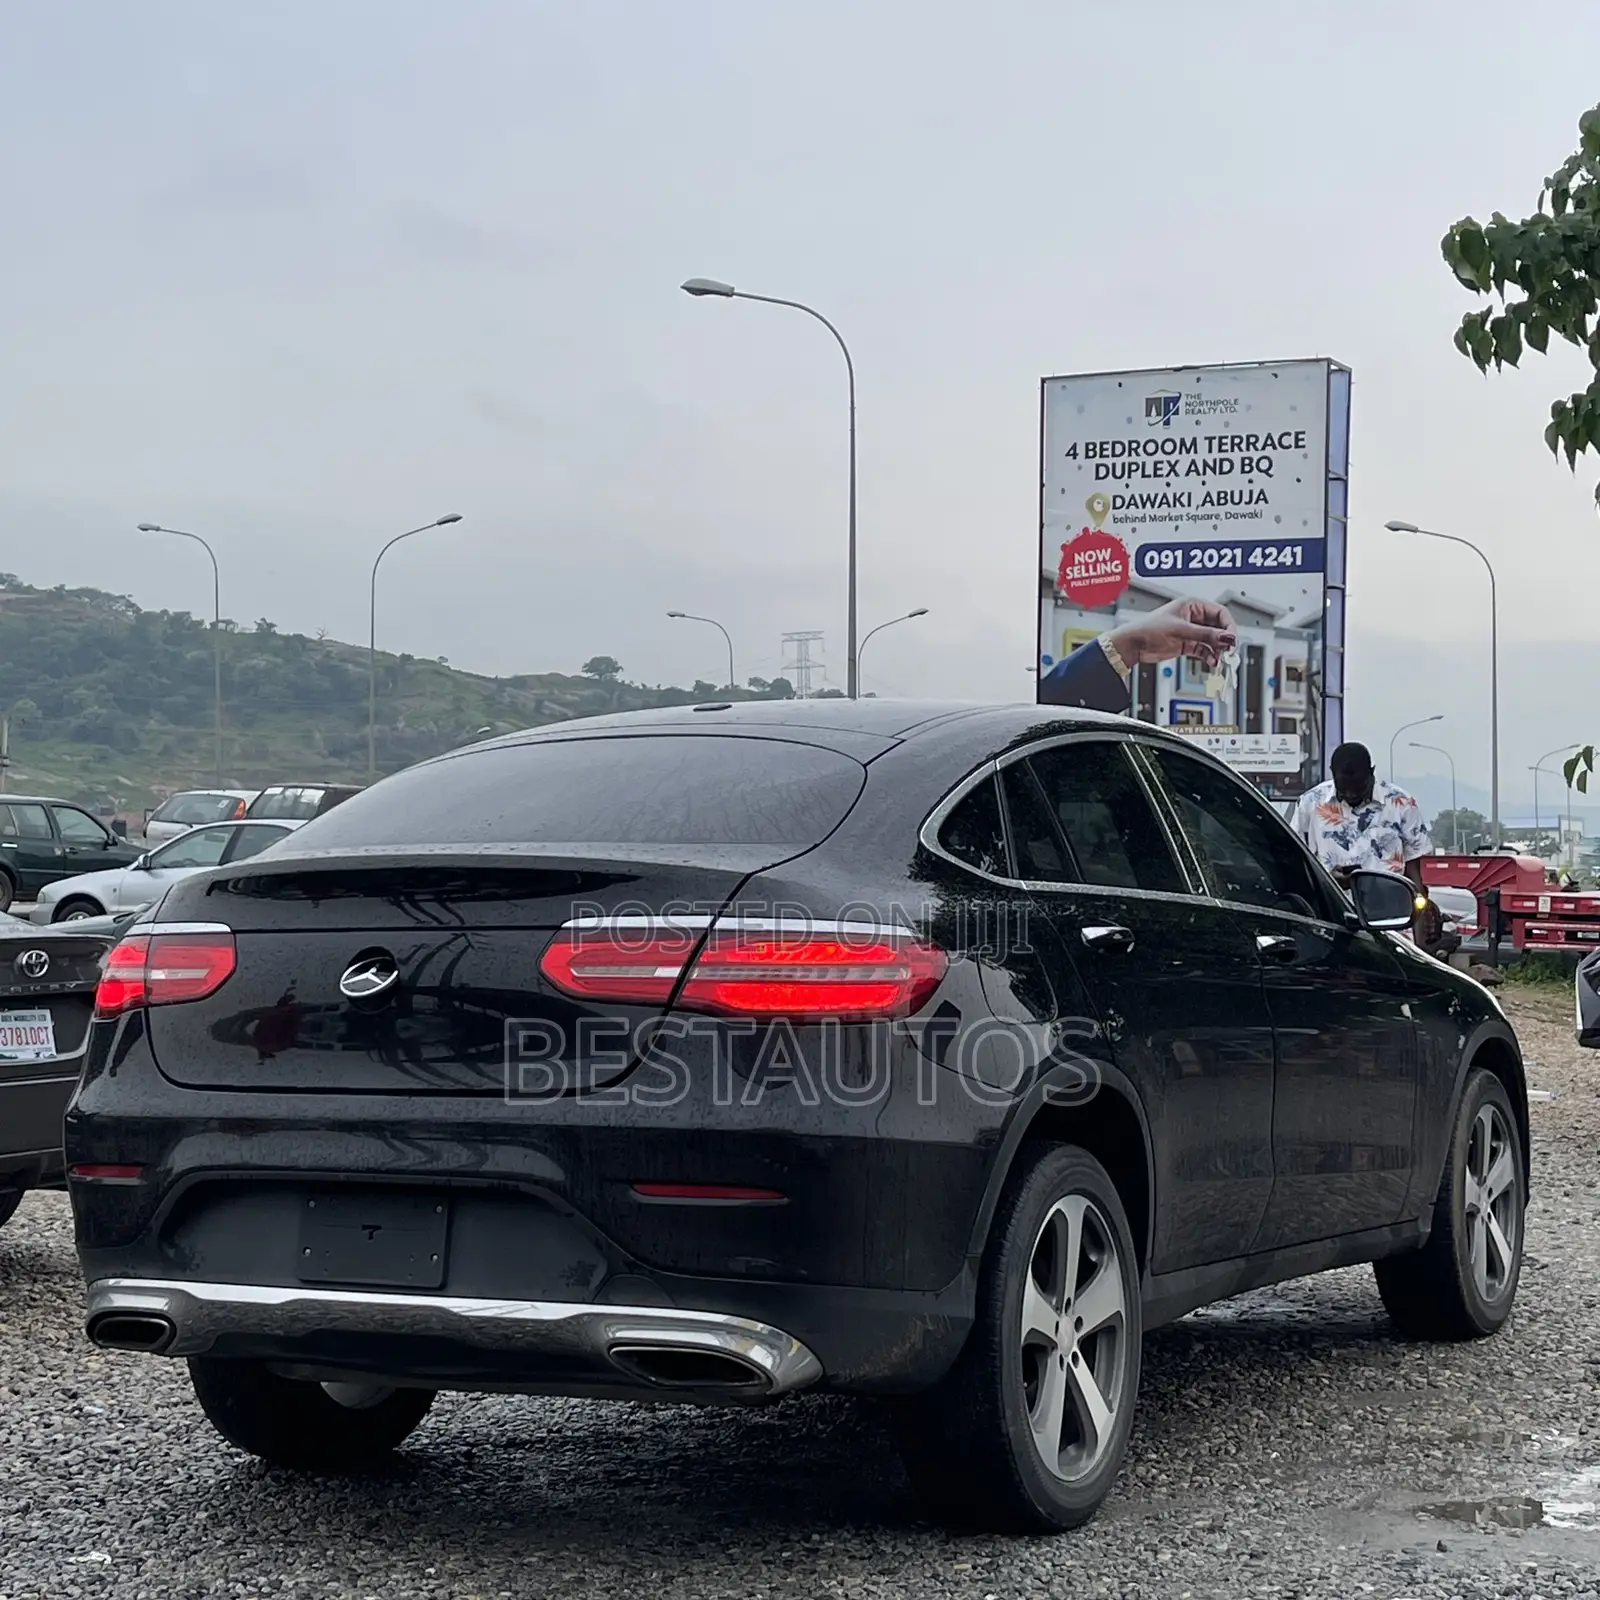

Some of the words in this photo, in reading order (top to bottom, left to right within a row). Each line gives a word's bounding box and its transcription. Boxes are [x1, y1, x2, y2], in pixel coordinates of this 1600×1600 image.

[1184, 398, 1239, 408] NORTHPOLE
[1184, 406, 1217, 415] REALTY
[1219, 405, 1238, 414] LTD.
[1065, 441, 1079, 460] 4
[1084, 436, 1198, 460] BEDROOM
[1204, 430, 1306, 454] TERRACE
[1094, 459, 1181, 481] DUPLEX
[1184, 457, 1235, 477] AND
[1240, 455, 1274, 478] BQ
[1112, 491, 1192, 510] DAWAKI
[1112, 513, 1147, 524] behind
[1148, 512, 1185, 523] Market
[1185, 511, 1223, 523] Square,
[1224, 509, 1263, 520] Dawaki
[1074, 547, 1112, 565] NOW
[1144, 549, 1183, 570] 091
[1188, 547, 1242, 569] 2021
[1248, 545, 1303, 567] 4241
[1065, 560, 1123, 580] SELLING
[1194, 726, 1234, 734] FEATURES
